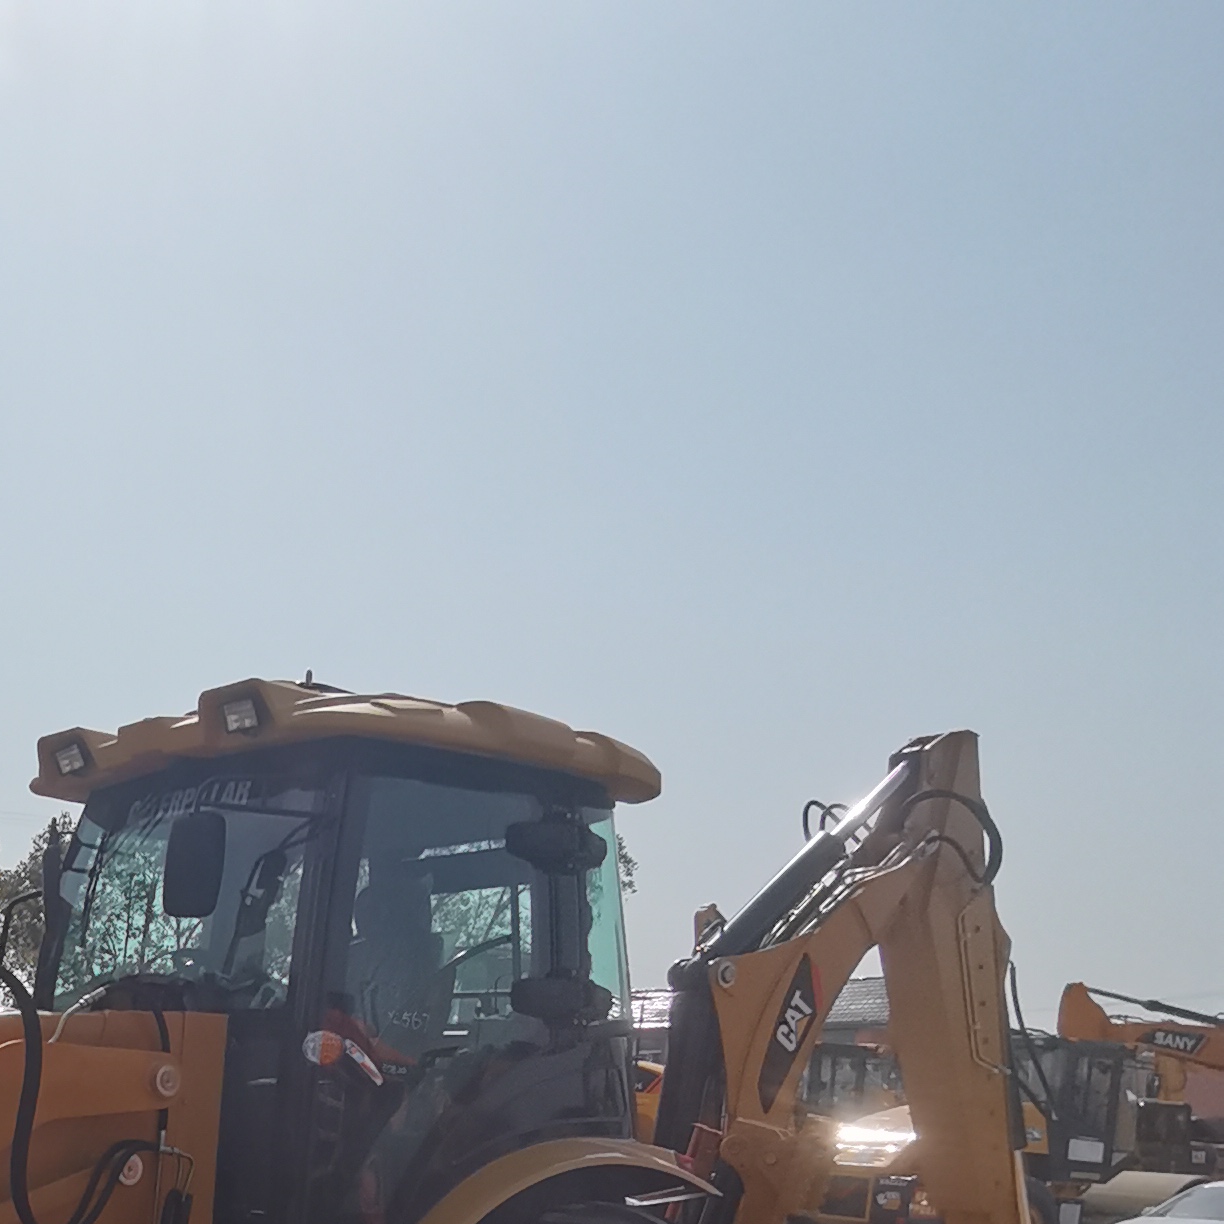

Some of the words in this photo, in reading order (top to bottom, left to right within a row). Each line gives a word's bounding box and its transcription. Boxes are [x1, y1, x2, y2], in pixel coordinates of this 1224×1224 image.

[126, 780, 252, 828] CERPLAR
[776, 989, 813, 1052] CAT
[1154, 1031, 1197, 1051] SANY
